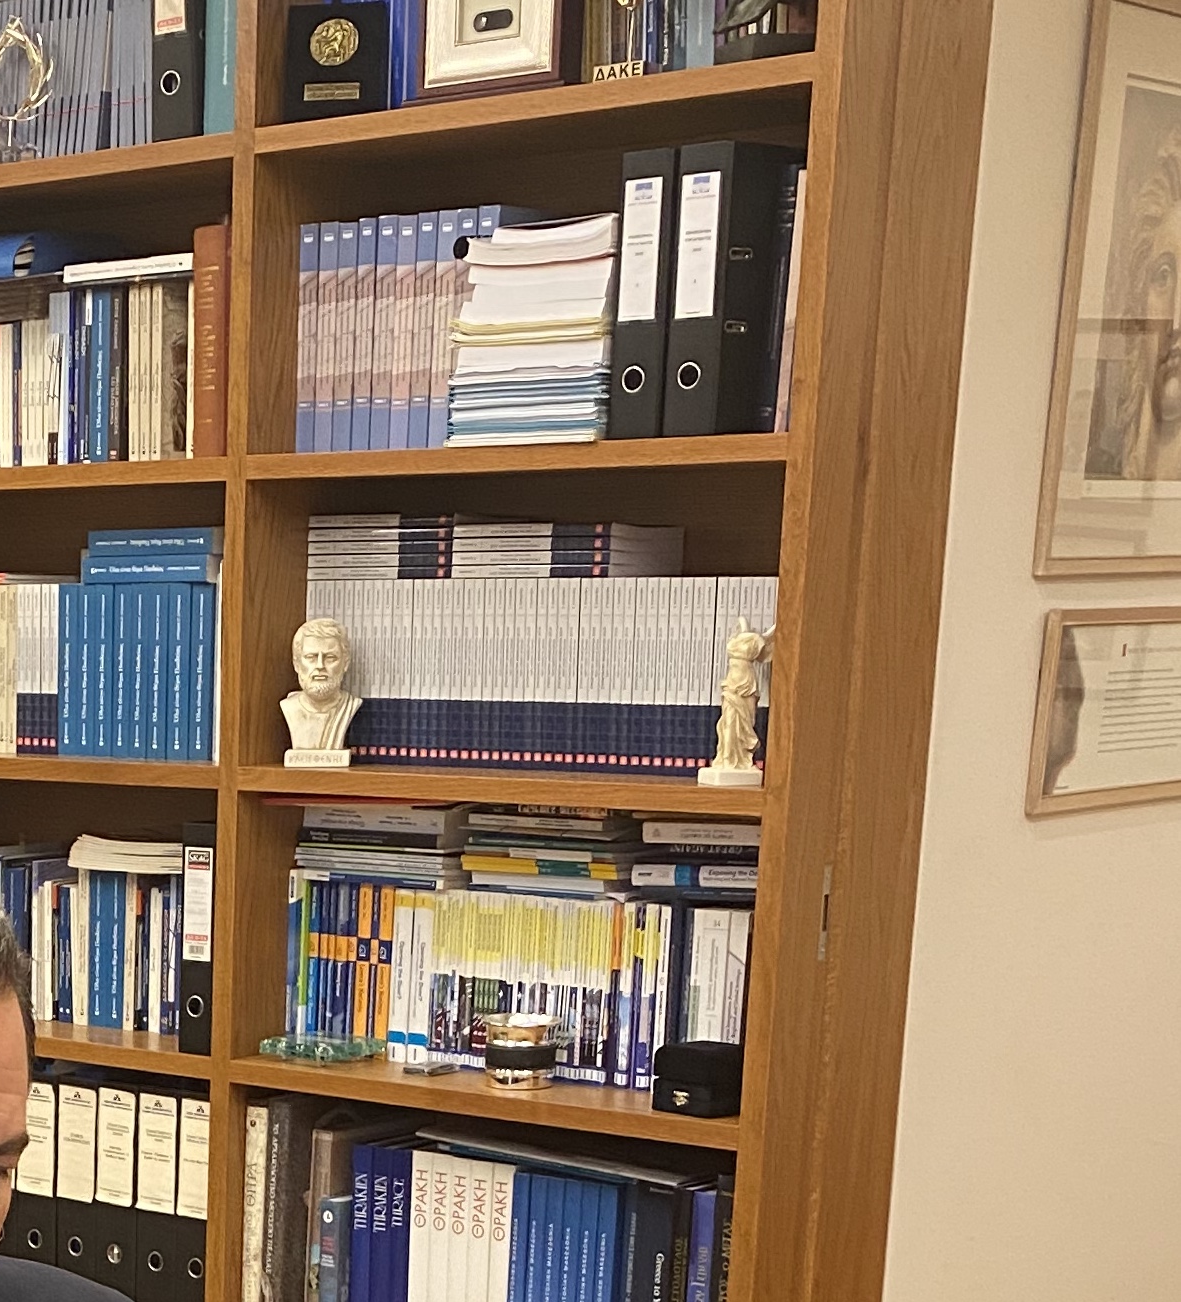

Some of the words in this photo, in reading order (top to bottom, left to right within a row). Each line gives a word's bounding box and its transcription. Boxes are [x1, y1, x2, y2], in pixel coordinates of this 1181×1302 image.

[594, 62, 641, 81] ΔΑΚΕ
[391, 1178, 405, 1227] THRACE
[413, 1169, 428, 1228] ΘΡΑΚΗ
[432, 1172, 447, 1231] ΘΡΑΚΗ
[451, 1175, 466, 1235] ΘΡΑΚΗ
[471, 1178, 487, 1239] ΘΡΑΚΗ
[492, 1181, 507, 1241] ΘΡΑΚΗ
[653, 1253, 665, 1284] Greece
